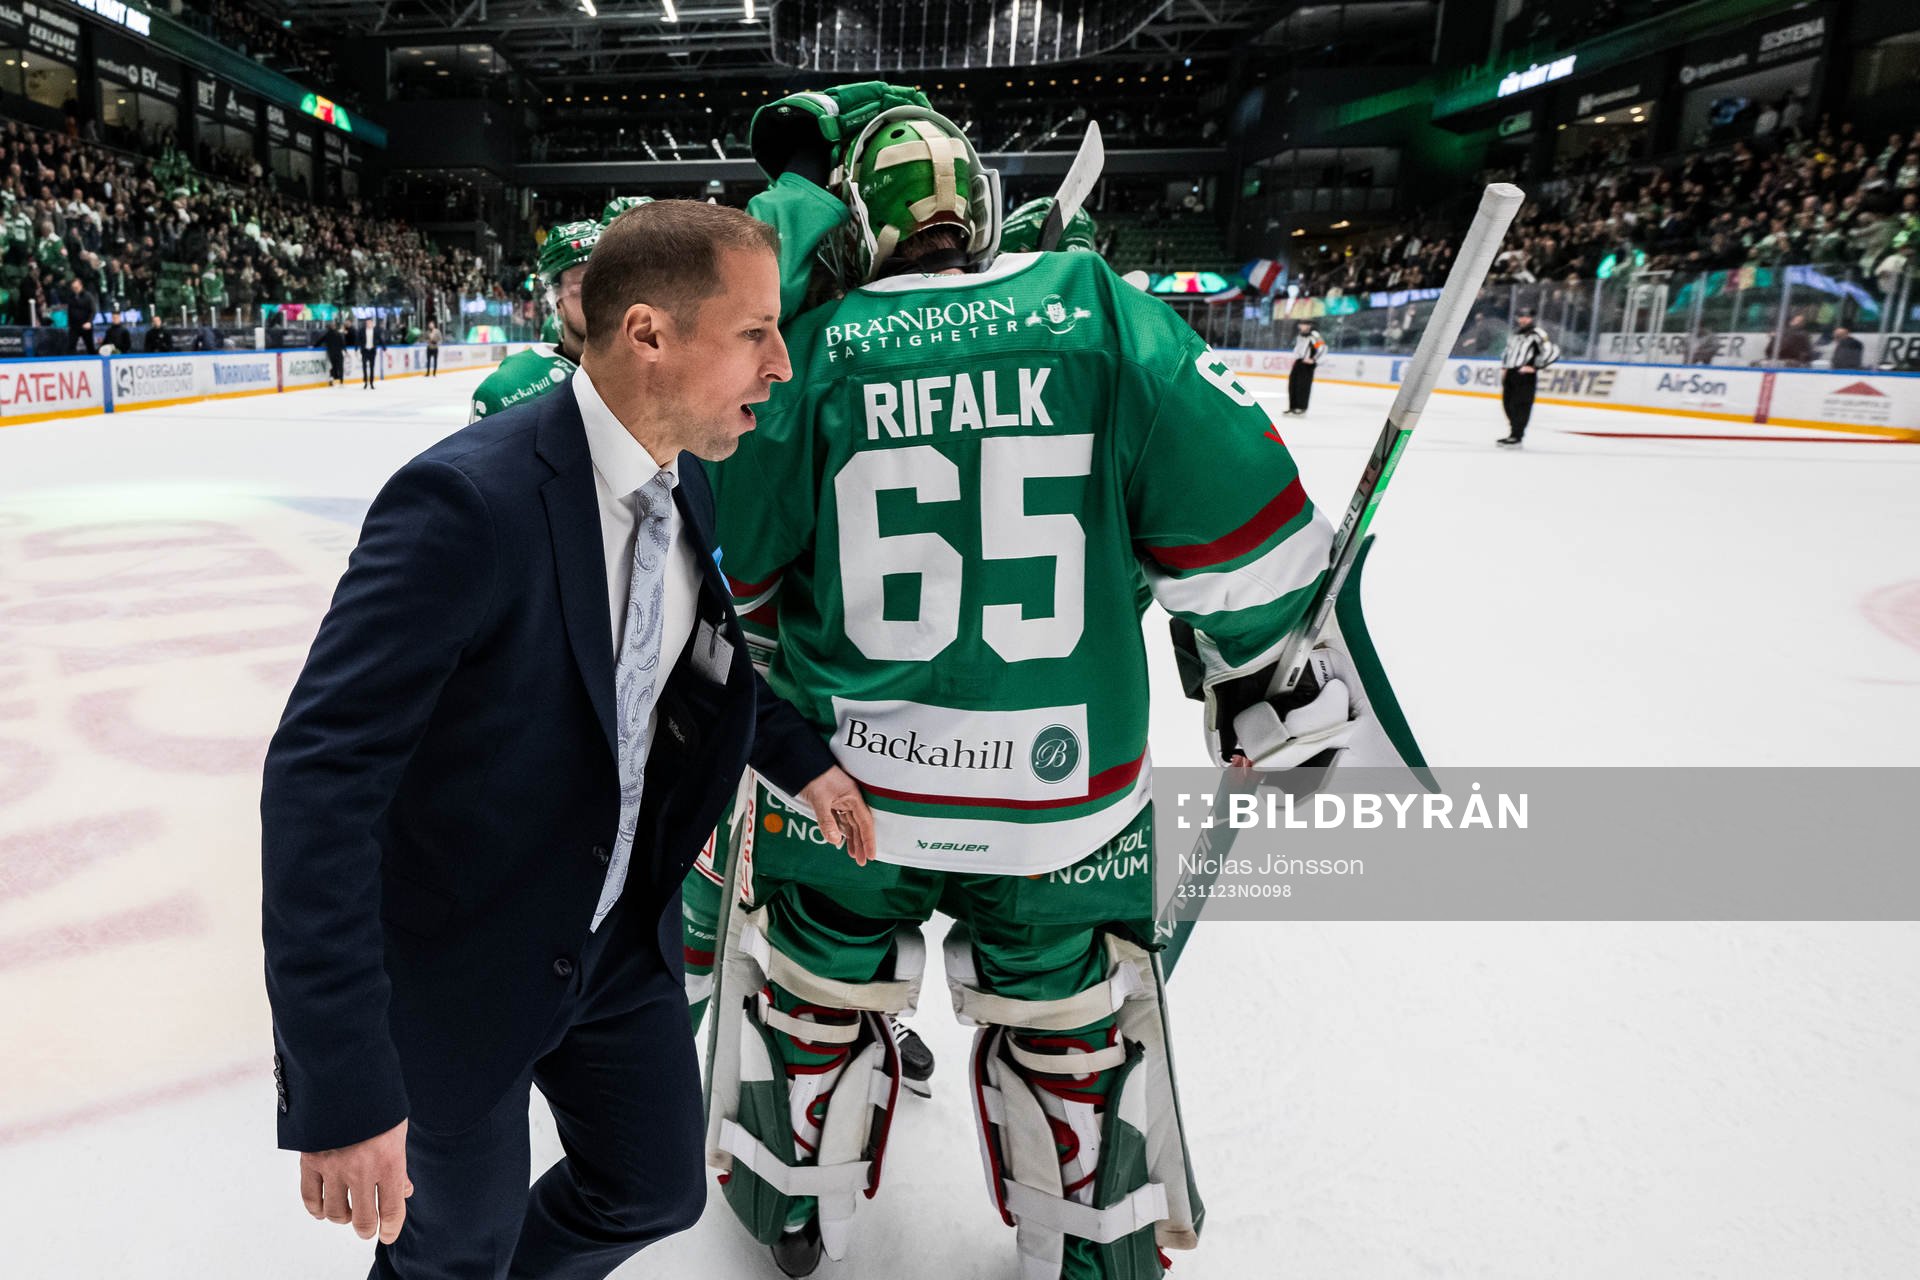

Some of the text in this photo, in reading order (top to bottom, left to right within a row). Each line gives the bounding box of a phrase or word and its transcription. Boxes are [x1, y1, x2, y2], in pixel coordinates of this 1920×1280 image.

[825, 297, 1016, 348] BRÄNNBORN
[828, 320, 1018, 363] FASTIGHETER
[501, 377, 551, 407] Backahill
[863, 367, 1054, 440] RIFALK
[1657, 373, 1727, 396] AirSon
[834, 433, 1095, 663] 65
[844, 718, 1014, 770] Backahill
[929, 842, 990, 853] BAUER
[1050, 854, 1148, 884] NOVUM
